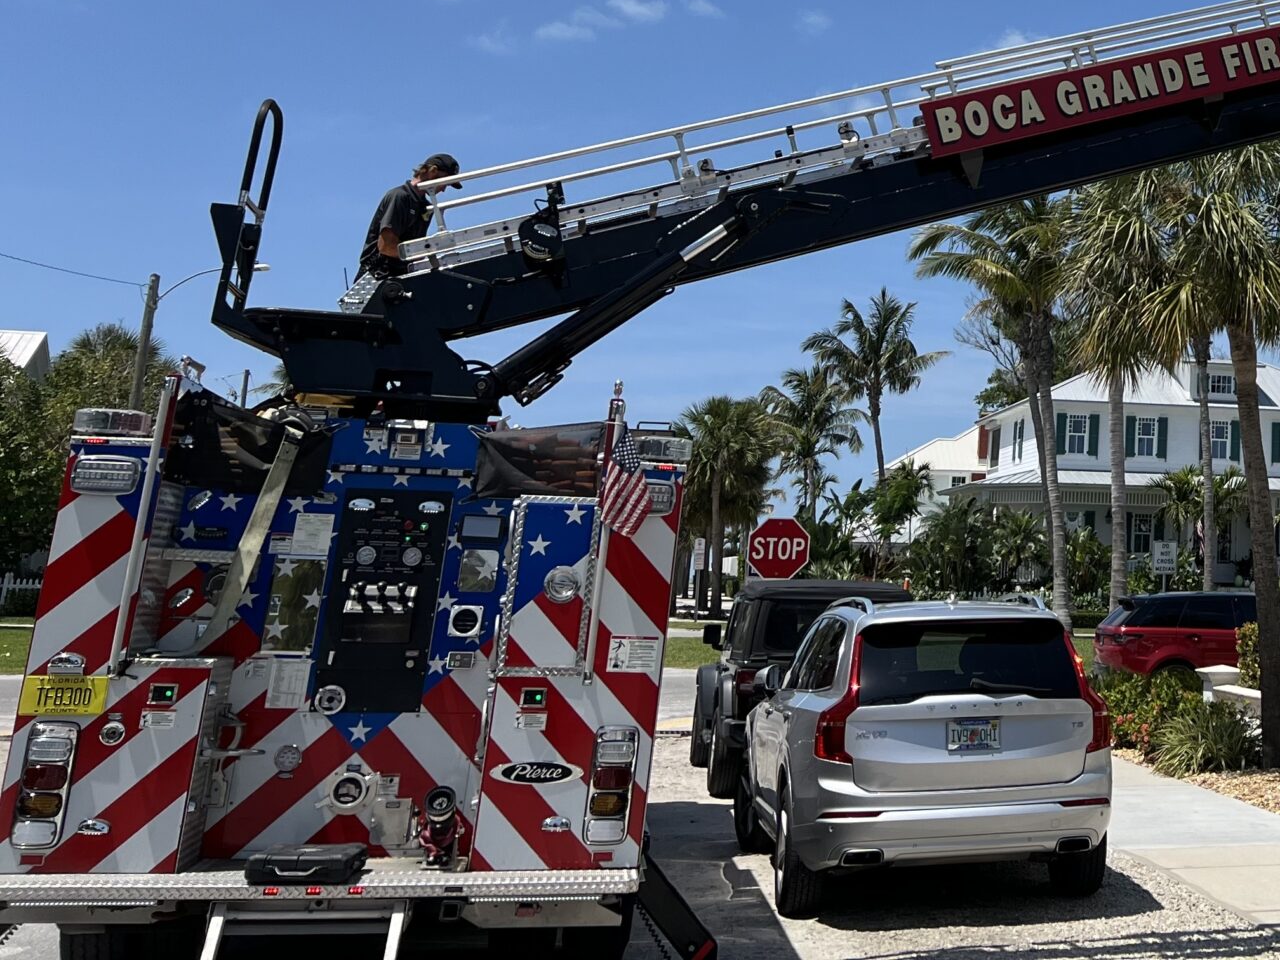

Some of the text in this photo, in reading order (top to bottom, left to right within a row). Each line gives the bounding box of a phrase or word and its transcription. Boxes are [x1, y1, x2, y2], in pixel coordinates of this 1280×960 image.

[935, 89, 1045, 143] BOCA
[1056, 51, 1210, 116] GRANDE
[751, 536, 806, 560] STOP
[37, 687, 92, 707] TF8300
[510, 764, 562, 780] Pierce
